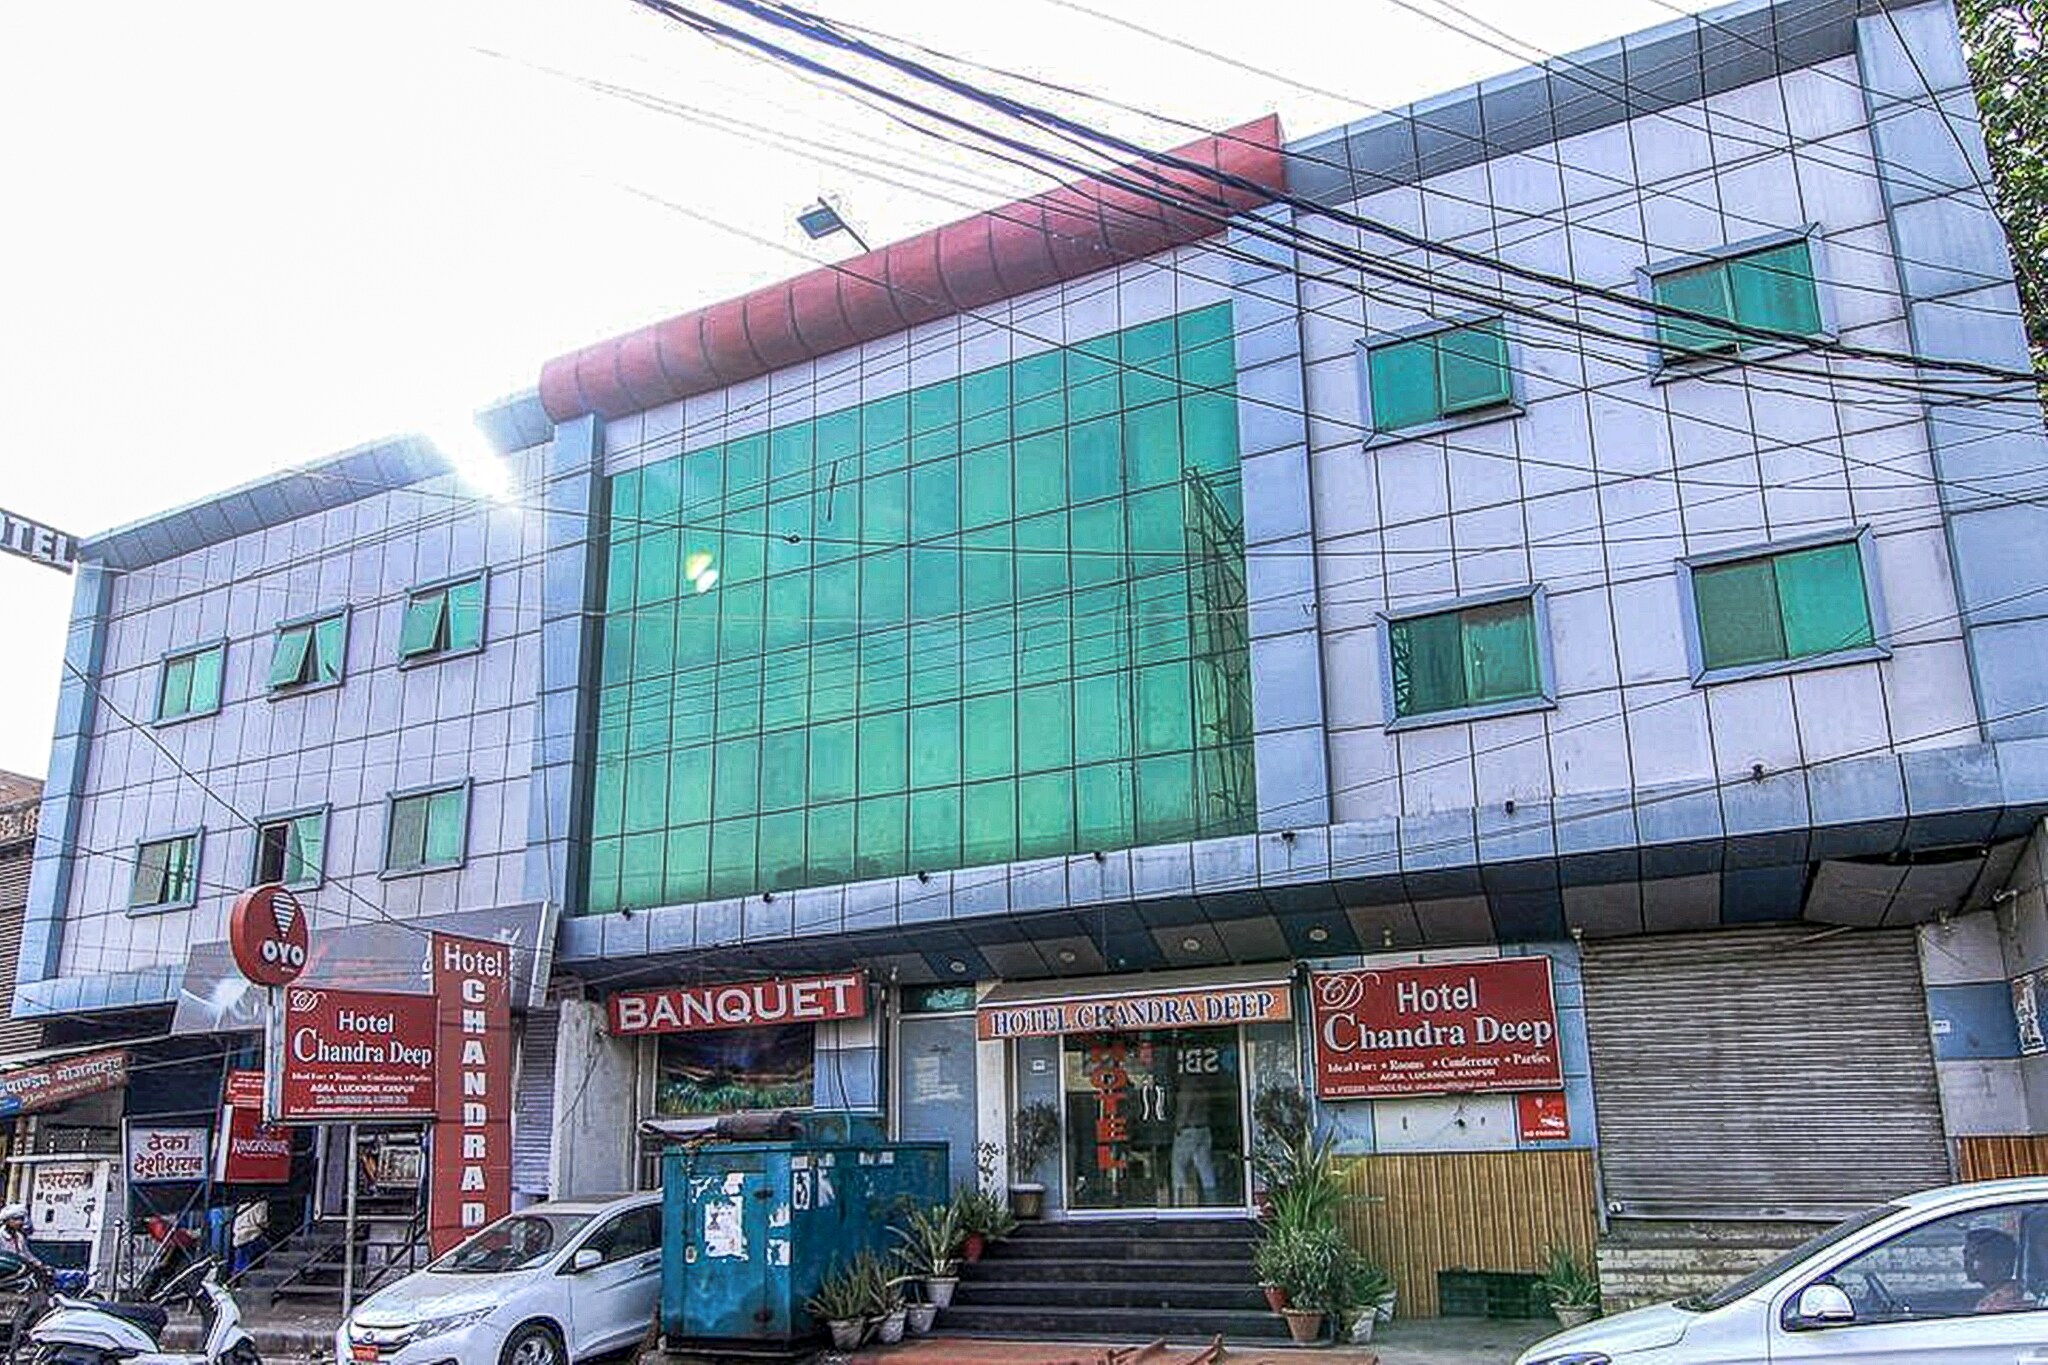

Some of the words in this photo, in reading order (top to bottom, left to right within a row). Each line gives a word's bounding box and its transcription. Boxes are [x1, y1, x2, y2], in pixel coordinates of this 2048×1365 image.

[0, 511, 71, 566] TEL
[262, 939, 304, 967] OYO
[444, 942, 502, 977] Hotel
[619, 977, 856, 1030] BANQUET
[990, 1008, 1069, 1037] HOTEL
[1077, 999, 1200, 1028] CHANDRA
[1205, 991, 1276, 1020] DEEP
[1398, 977, 1477, 1014] Hotel
[338, 1010, 394, 1033] Hotel
[1323, 1013, 1466, 1051] Chandra
[1474, 1016, 1552, 1048] Deep
[294, 1027, 384, 1062] Chandra
[390, 1041, 432, 1069] Deep
[1441, 1056, 1500, 1068] Conference
[1512, 1053, 1551, 1065] Parties
[147, 1132, 191, 1151] ठेका
